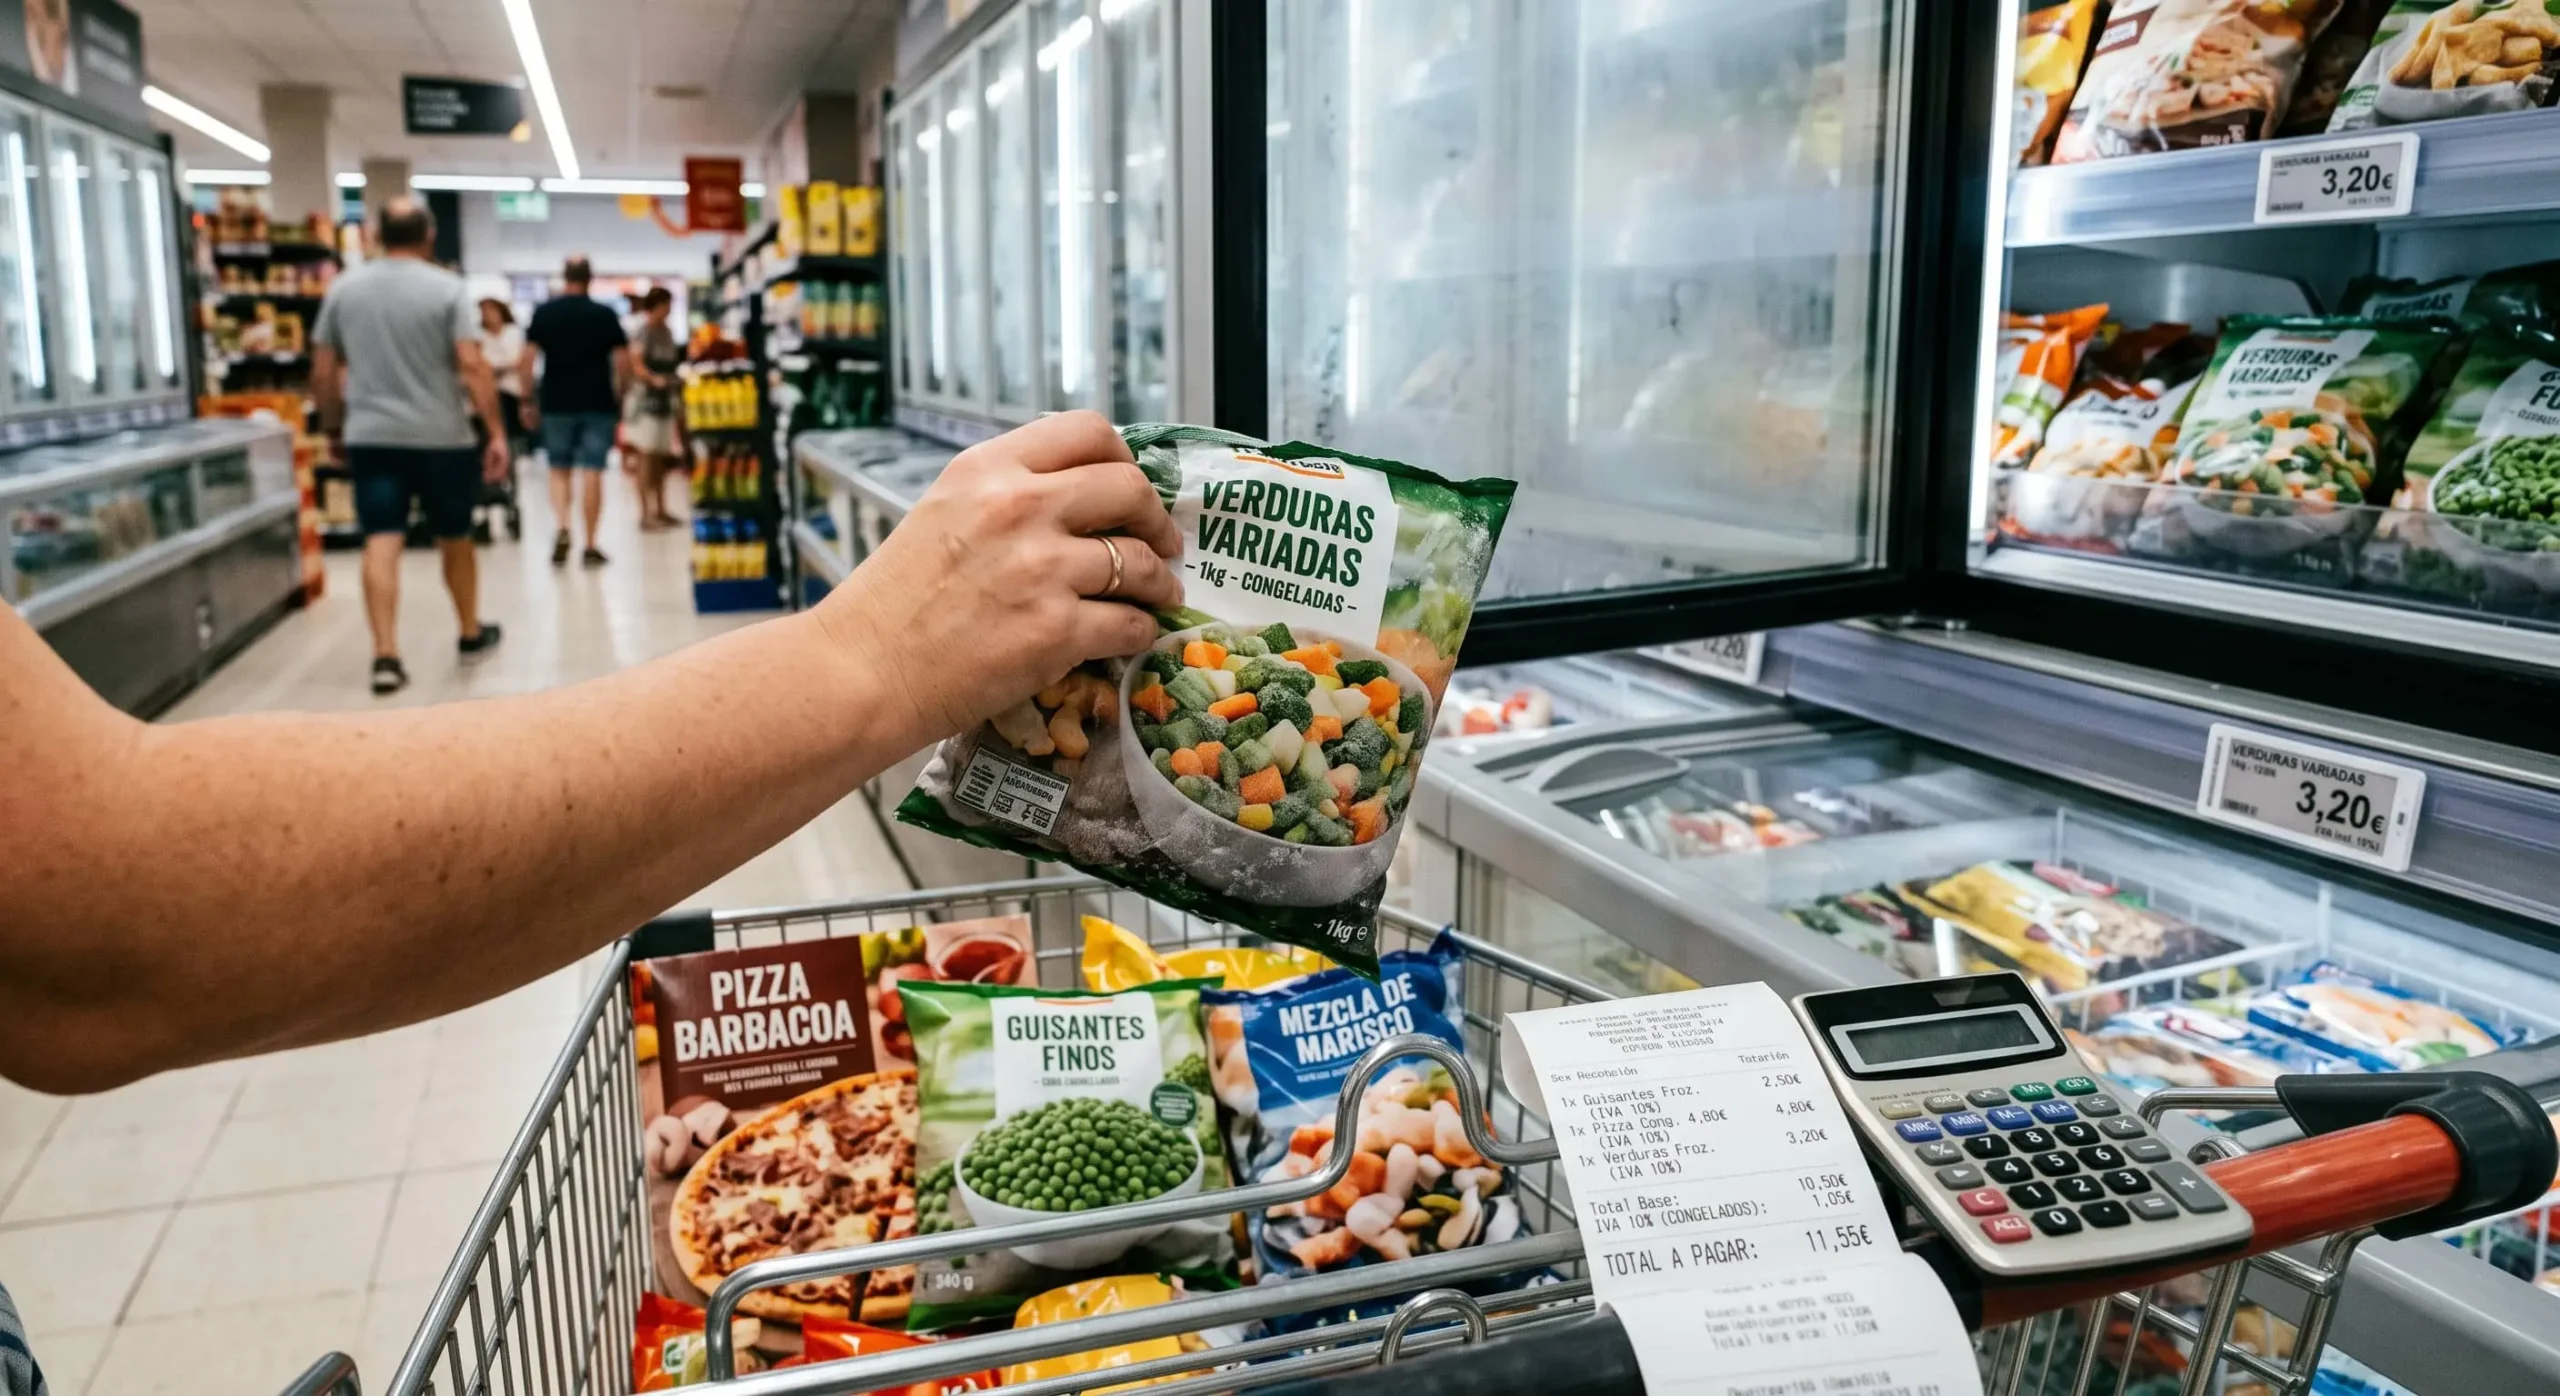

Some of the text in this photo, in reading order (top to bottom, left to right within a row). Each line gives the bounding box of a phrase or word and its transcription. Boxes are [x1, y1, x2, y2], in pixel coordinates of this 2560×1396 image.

[2321, 164, 2393, 199] 3,20€
[2239, 347, 2338, 367] VERDURAS
[2227, 366, 2318, 386] VARIADAS
[1202, 479, 1375, 543] VERDURAS
[1198, 514, 1362, 587] VARIADAS
[1199, 561, 1344, 614] 1kg CONGELADAS
[2231, 743, 2298, 769] VERDURAS
[2301, 760, 2367, 787] VARIADAS
[2296, 780, 2385, 835] 3,20€
[1326, 919, 1354, 943] 1kg
[710, 961, 811, 1012] PIZZA
[1278, 972, 1417, 1037] MEZCLA DE
[673, 999, 857, 1062] BARBACOA
[1007, 1014, 1145, 1041] GUISANTES
[1295, 1007, 1415, 1065] MARISCO
[1042, 1045, 1116, 1071] FINOS
[1561, 1073, 1802, 1108] 1x Guisantes Froz. 2,50€
[1590, 1100, 1661, 1120] (IVA 10%)
[1569, 1124, 1586, 1137] 1x
[1592, 1119, 1634, 1134] Pizza
[2025, 1131, 2043, 1143] 8
[2069, 1125, 2085, 1138] 9
[1579, 1128, 1828, 1167] 1x Verduras Froz. 3,20€
[1599, 1130, 1671, 1150] (IVA 10%)
[1978, 1137, 1992, 1149] 7
[2048, 1154, 2065, 1167] 5
[2095, 1148, 2112, 1161] 6
[1609, 1159, 1682, 1181] (IVA 10%)
[2003, 1161, 2019, 1174] 4
[2118, 1172, 2137, 1185] 3
[1589, 1174, 1848, 1217] Total Base: 10,50€
[2026, 1185, 2042, 1199] 1
[2072, 1178, 2091, 1193] 2
[1975, 1192, 1995, 1206] C
[1596, 1190, 1855, 1233] IVA 10% (CONGELADOS): 1,05€
[2049, 1210, 2068, 1226] 0
[1603, 1224, 1873, 1277] TOTAL A PAGAR: 11,55€
[964, 1275, 974, 1291] g
